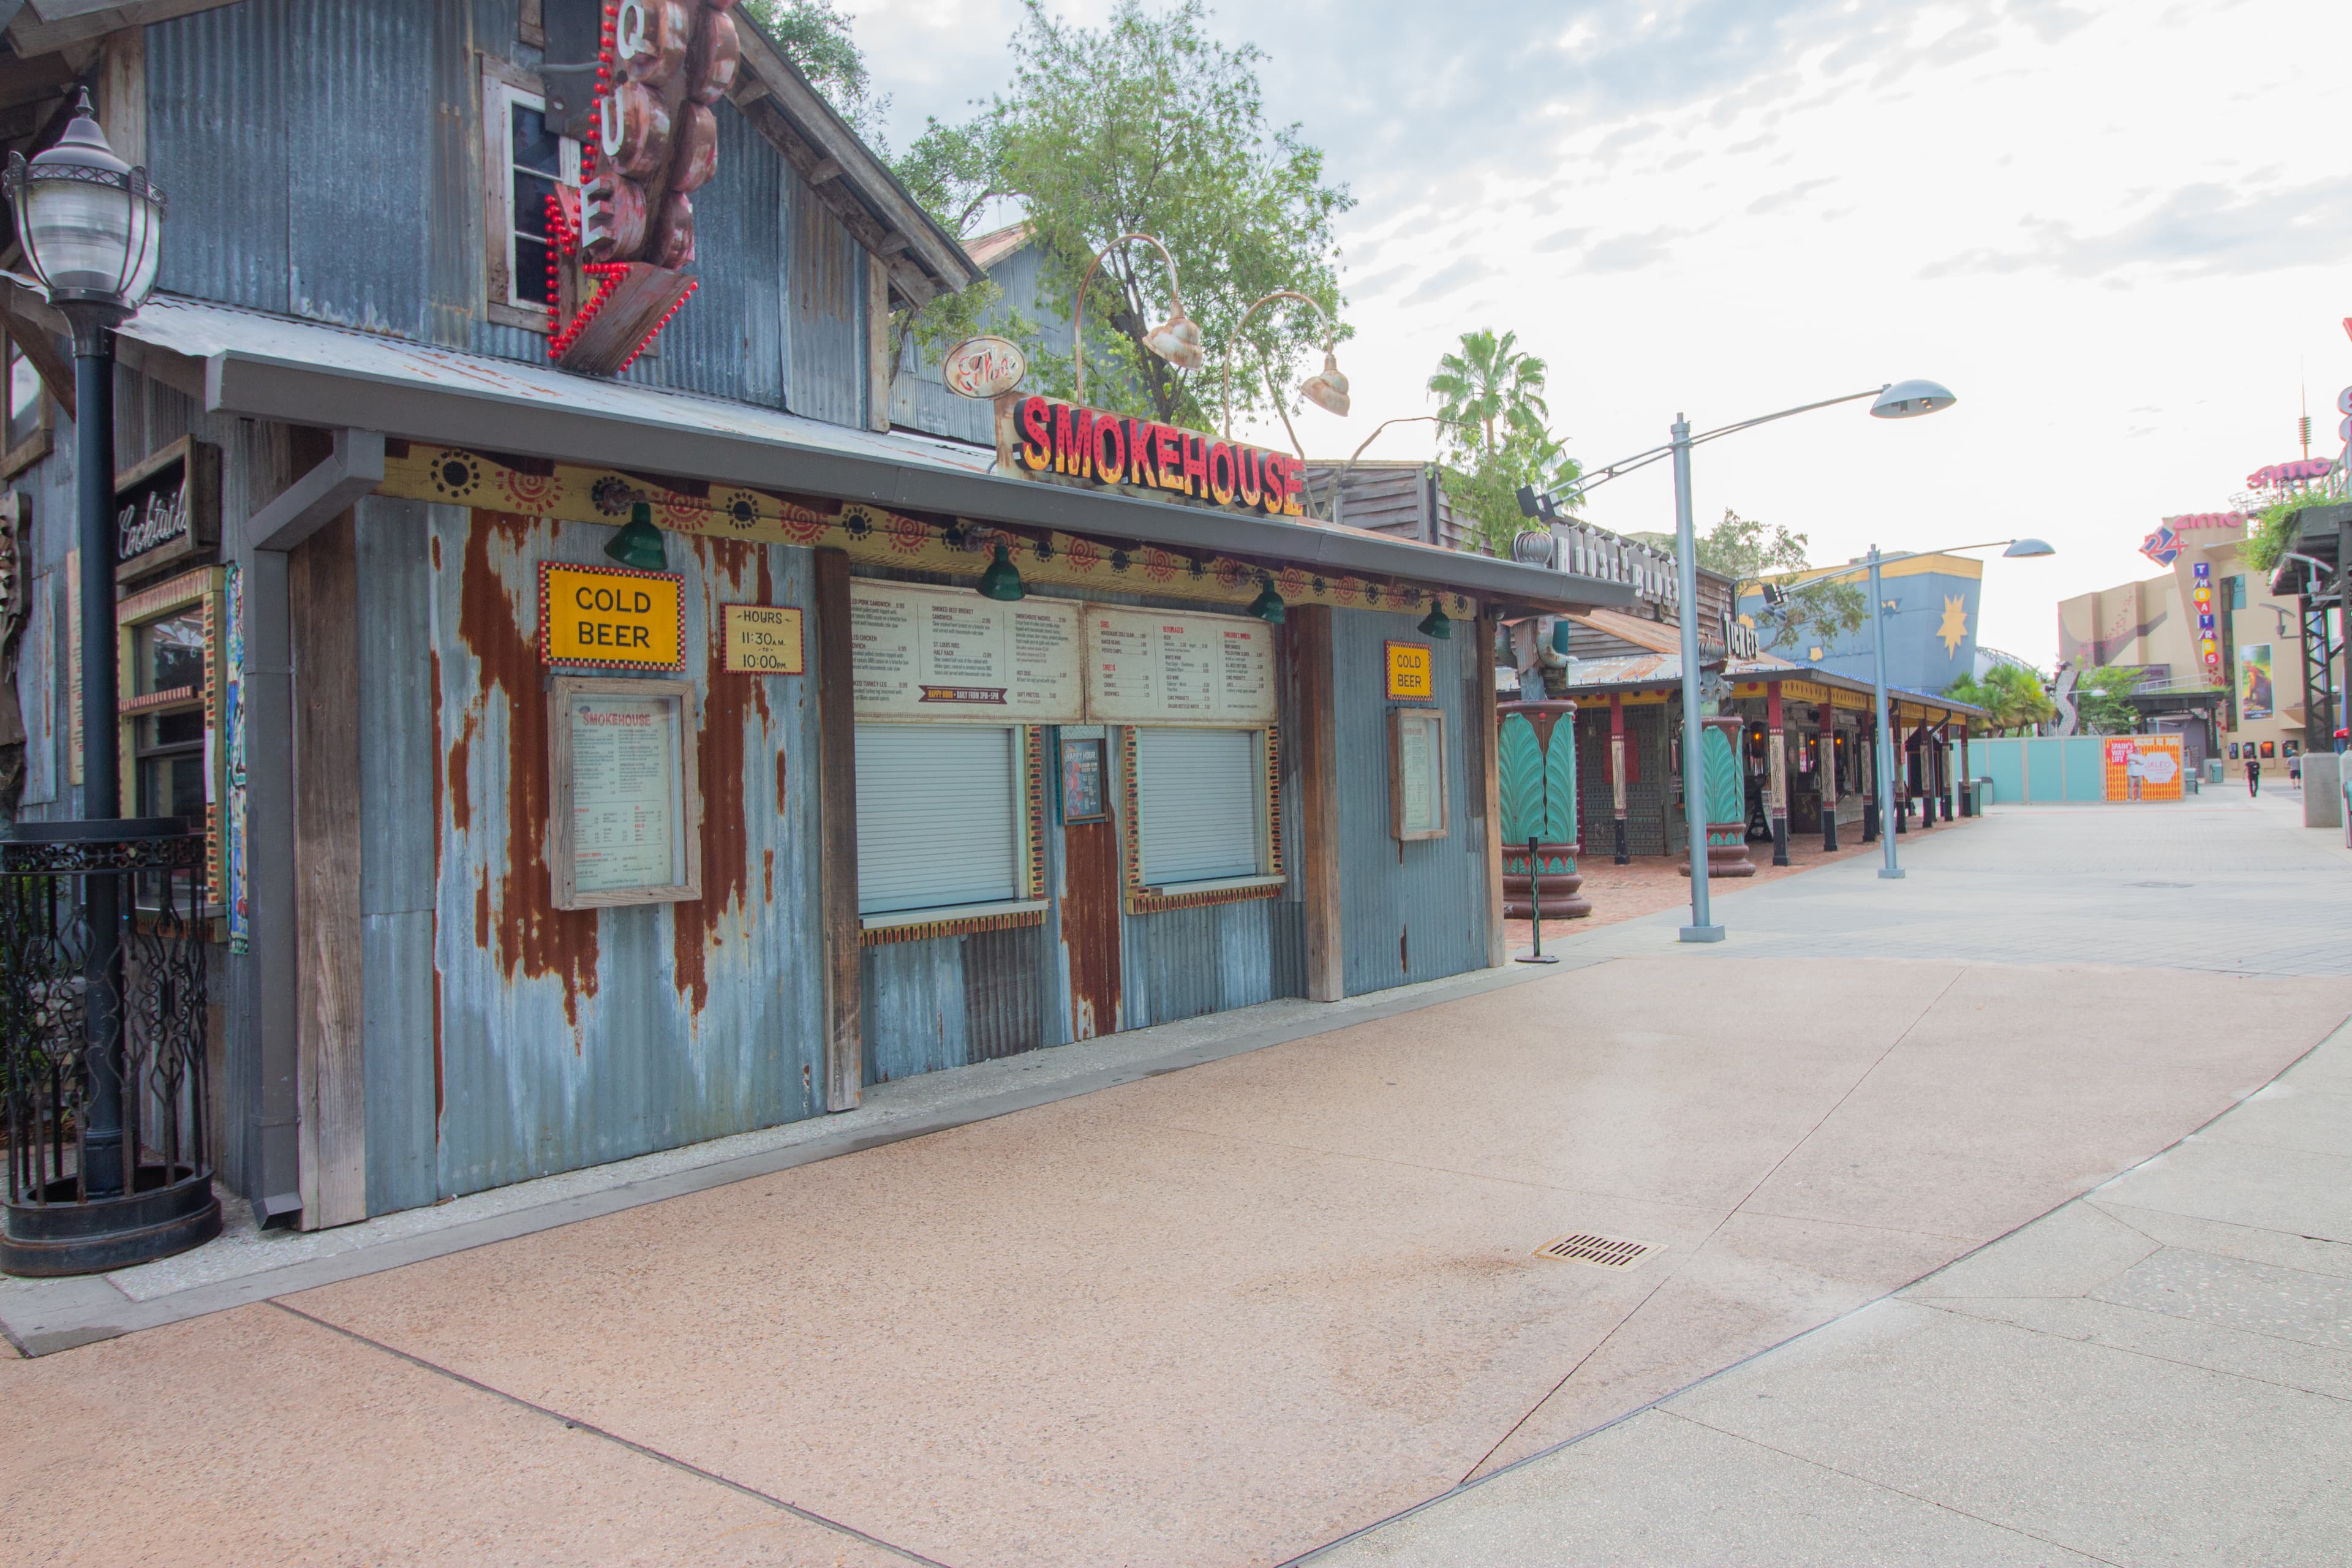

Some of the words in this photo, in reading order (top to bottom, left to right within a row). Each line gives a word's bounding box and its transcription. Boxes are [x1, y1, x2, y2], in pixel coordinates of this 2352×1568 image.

[1014, 396, 1303, 516] SMOKEHOUSE
[2174, 511, 2245, 529] amc
[2143, 530, 2189, 556] 24
[1558, 537, 1621, 583] HOUSE
[575, 586, 651, 614] COLD
[744, 610, 782, 625] HOURS
[2196, 565, 2217, 663] THEATRES
[578, 621, 651, 649] BEER
[1723, 612, 1759, 658] TICKETS
[1396, 654, 1421, 669] COLD
[1397, 674, 1422, 688] BEER
[928, 690, 941, 699] HAPPY
[942, 690, 953, 699] HOUR
[956, 691, 968, 699] DAILY
[968, 691, 979, 700] FROM
[582, 712, 651, 727] SMOKEHOUSE
[1066, 752, 1082, 761] HAPPY
[1083, 751, 1096, 760] HOUR
